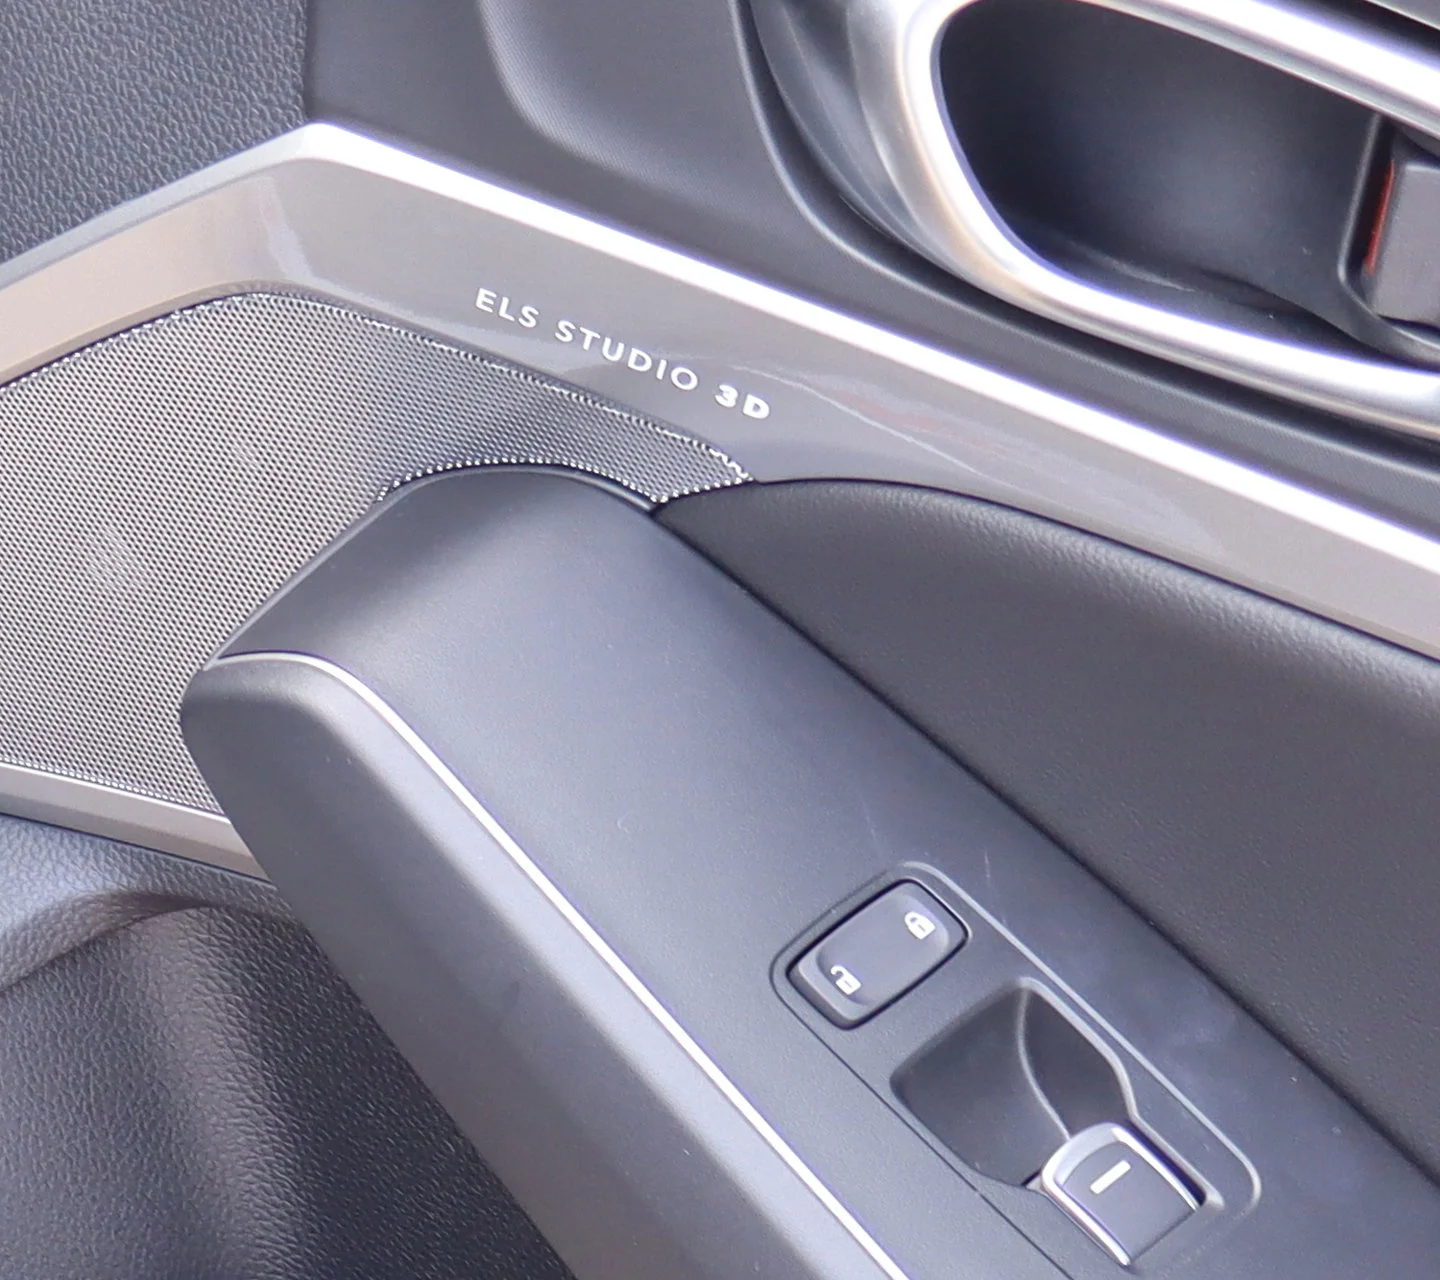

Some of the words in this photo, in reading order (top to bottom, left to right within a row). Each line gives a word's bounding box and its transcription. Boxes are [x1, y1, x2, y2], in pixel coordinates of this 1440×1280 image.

[475, 287, 540, 328] ELS
[554, 319, 699, 391] STUDIO
[714, 383, 771, 420] 3D
